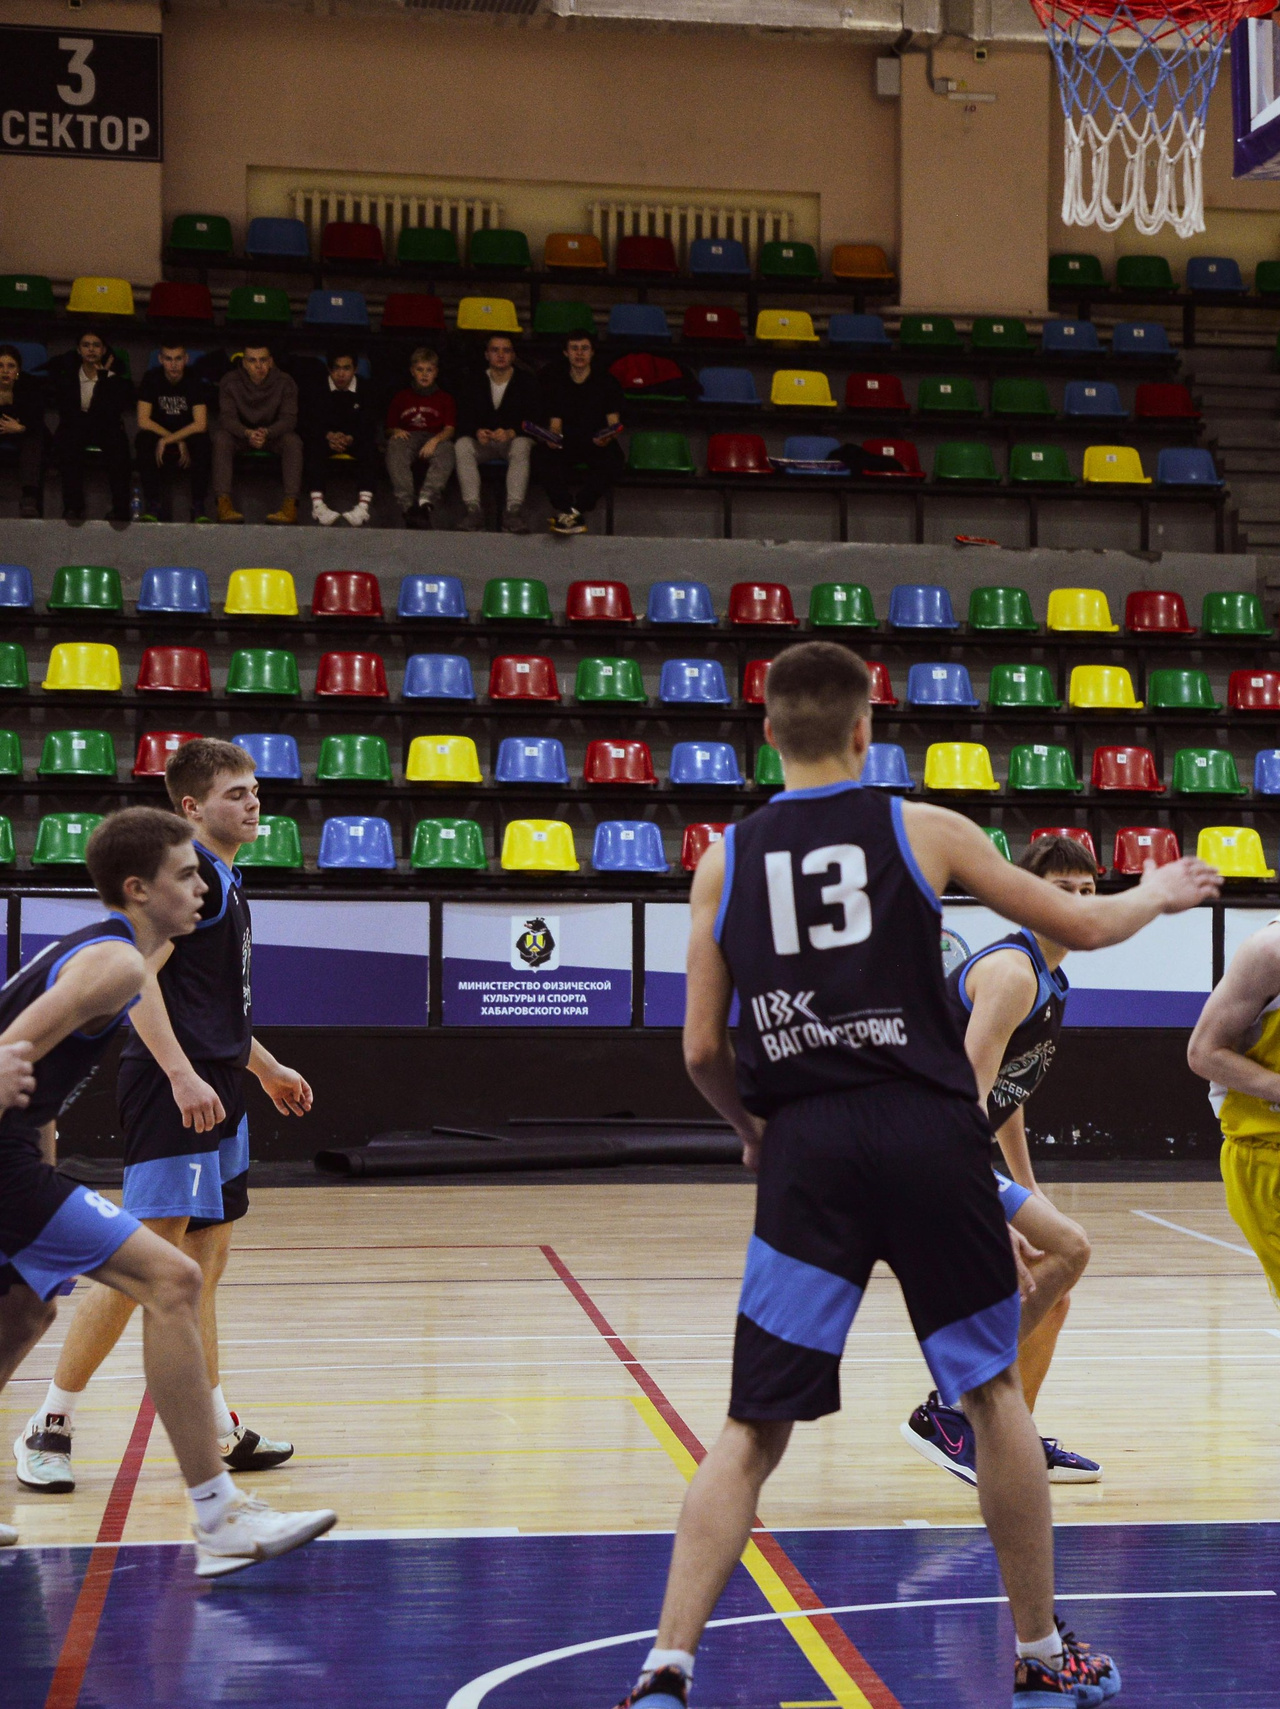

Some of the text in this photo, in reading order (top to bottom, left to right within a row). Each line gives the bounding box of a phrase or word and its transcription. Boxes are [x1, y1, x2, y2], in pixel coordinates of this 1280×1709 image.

[56, 37, 96, 106] 3
[2, 109, 150, 151] СЕКТОР
[764, 843, 873, 956] 13
[458, 980, 612, 991] МИНИСТЕРСТВО ФИЗИЧЕСКОЙ
[483, 994, 587, 1003] КУЛЬТУРЫ И СПОРТА
[481, 1006, 589, 1016] ХАБАРОВСКОГО КРАЯ
[761, 1017, 908, 1063] ВАГОНСЕРВИС
[189, 1162, 202, 1197] 7
[84, 1191, 120, 1218] 8
